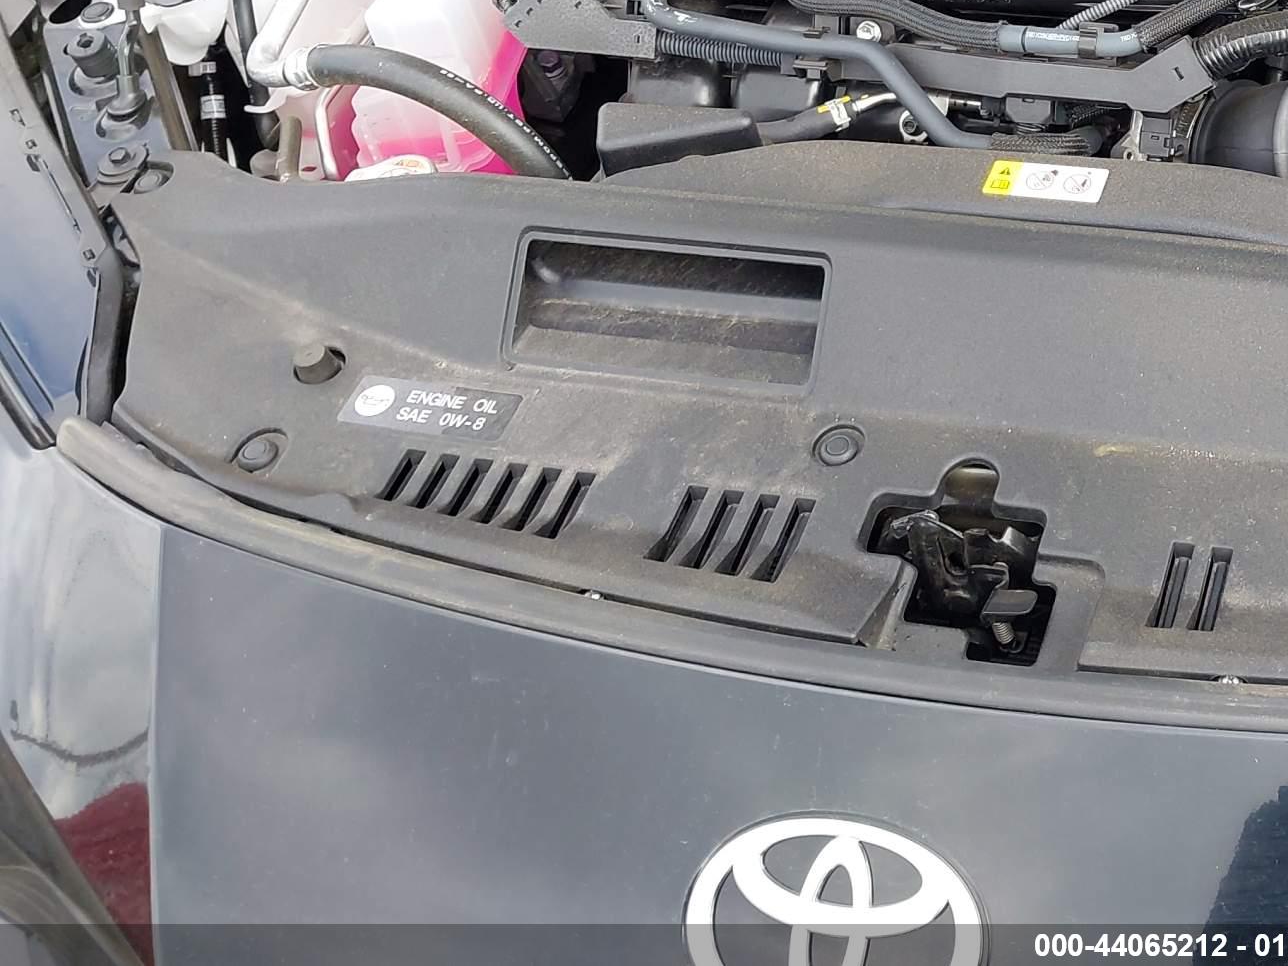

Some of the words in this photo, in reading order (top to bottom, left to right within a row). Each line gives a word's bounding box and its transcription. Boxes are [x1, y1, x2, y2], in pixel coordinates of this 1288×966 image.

[406, 390, 467, 409] ENGINE
[473, 398, 498, 414] OIL
[396, 406, 432, 423] SAE
[439, 412, 487, 431] 0W-8
